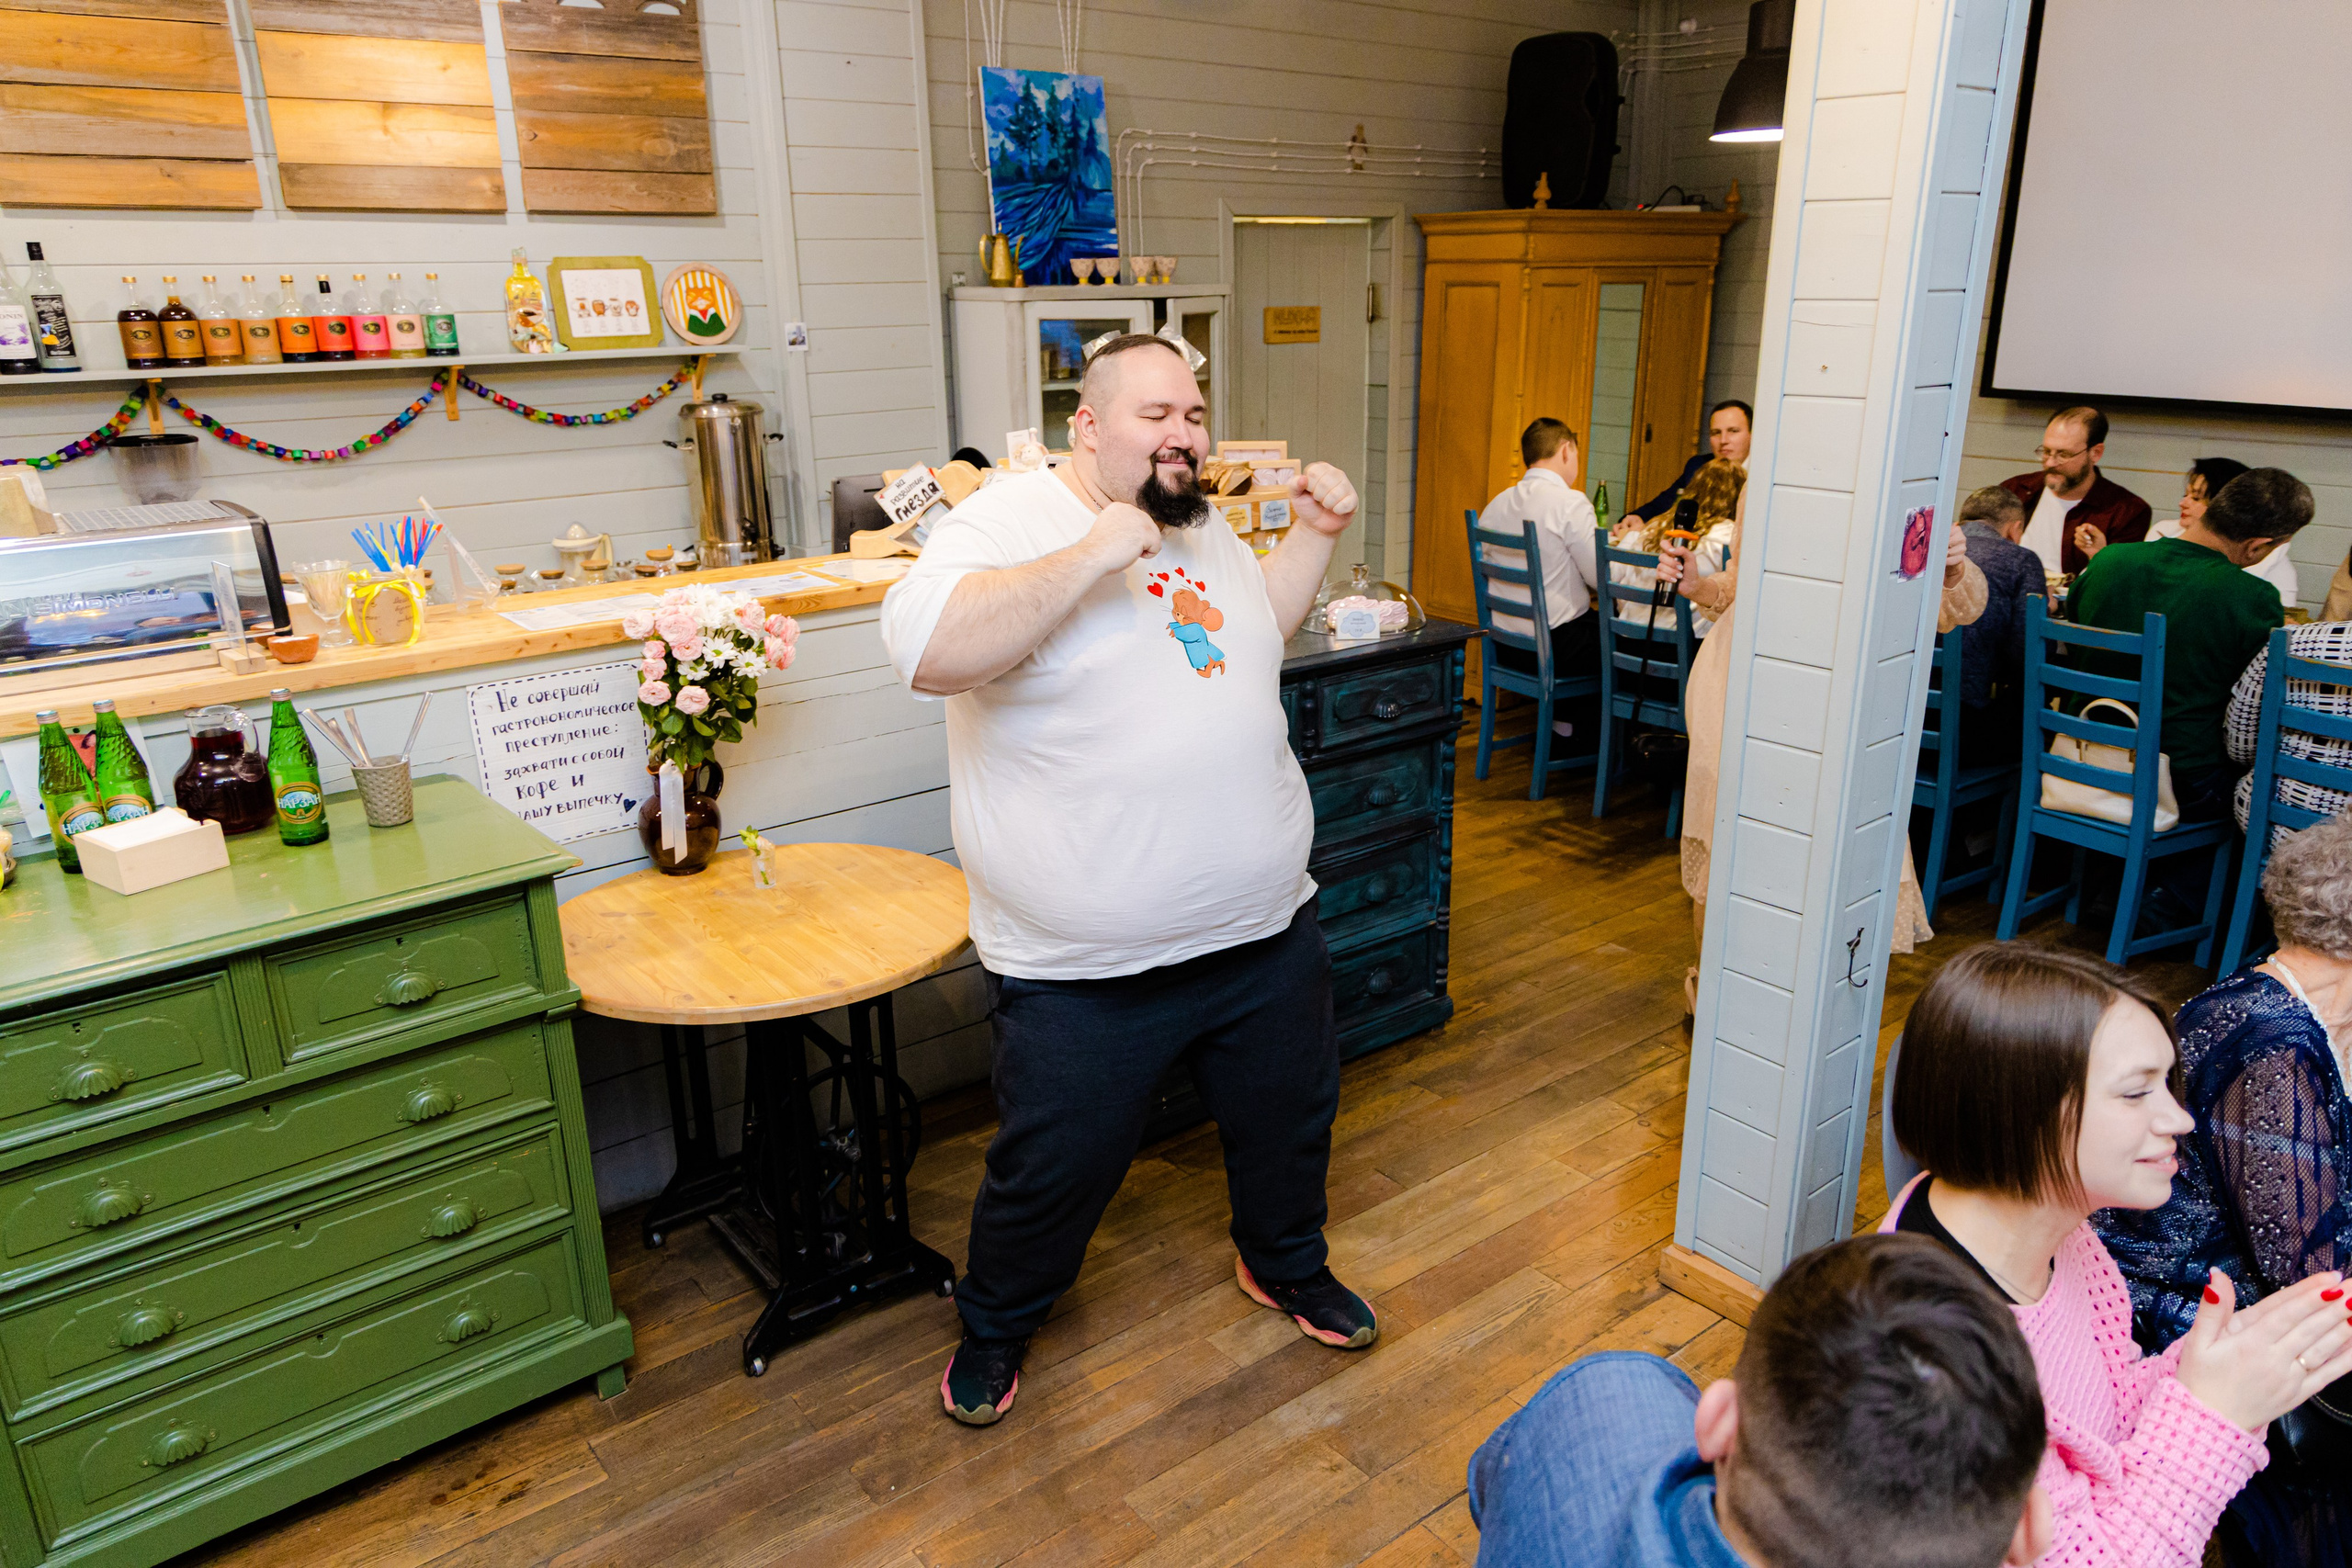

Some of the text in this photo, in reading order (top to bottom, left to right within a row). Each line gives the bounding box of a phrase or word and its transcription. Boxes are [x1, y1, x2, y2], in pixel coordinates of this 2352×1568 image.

[889, 476, 926, 506] развитие
[895, 479, 906, 490] на
[29, 587, 178, 616] SIMONELLI
[495, 679, 600, 712] Не совершай
[503, 756, 567, 781] захвати
[582, 745, 625, 762] собой
[277, 793, 322, 808] НАРЗАН
[62, 818, 103, 835] НАРЗА
